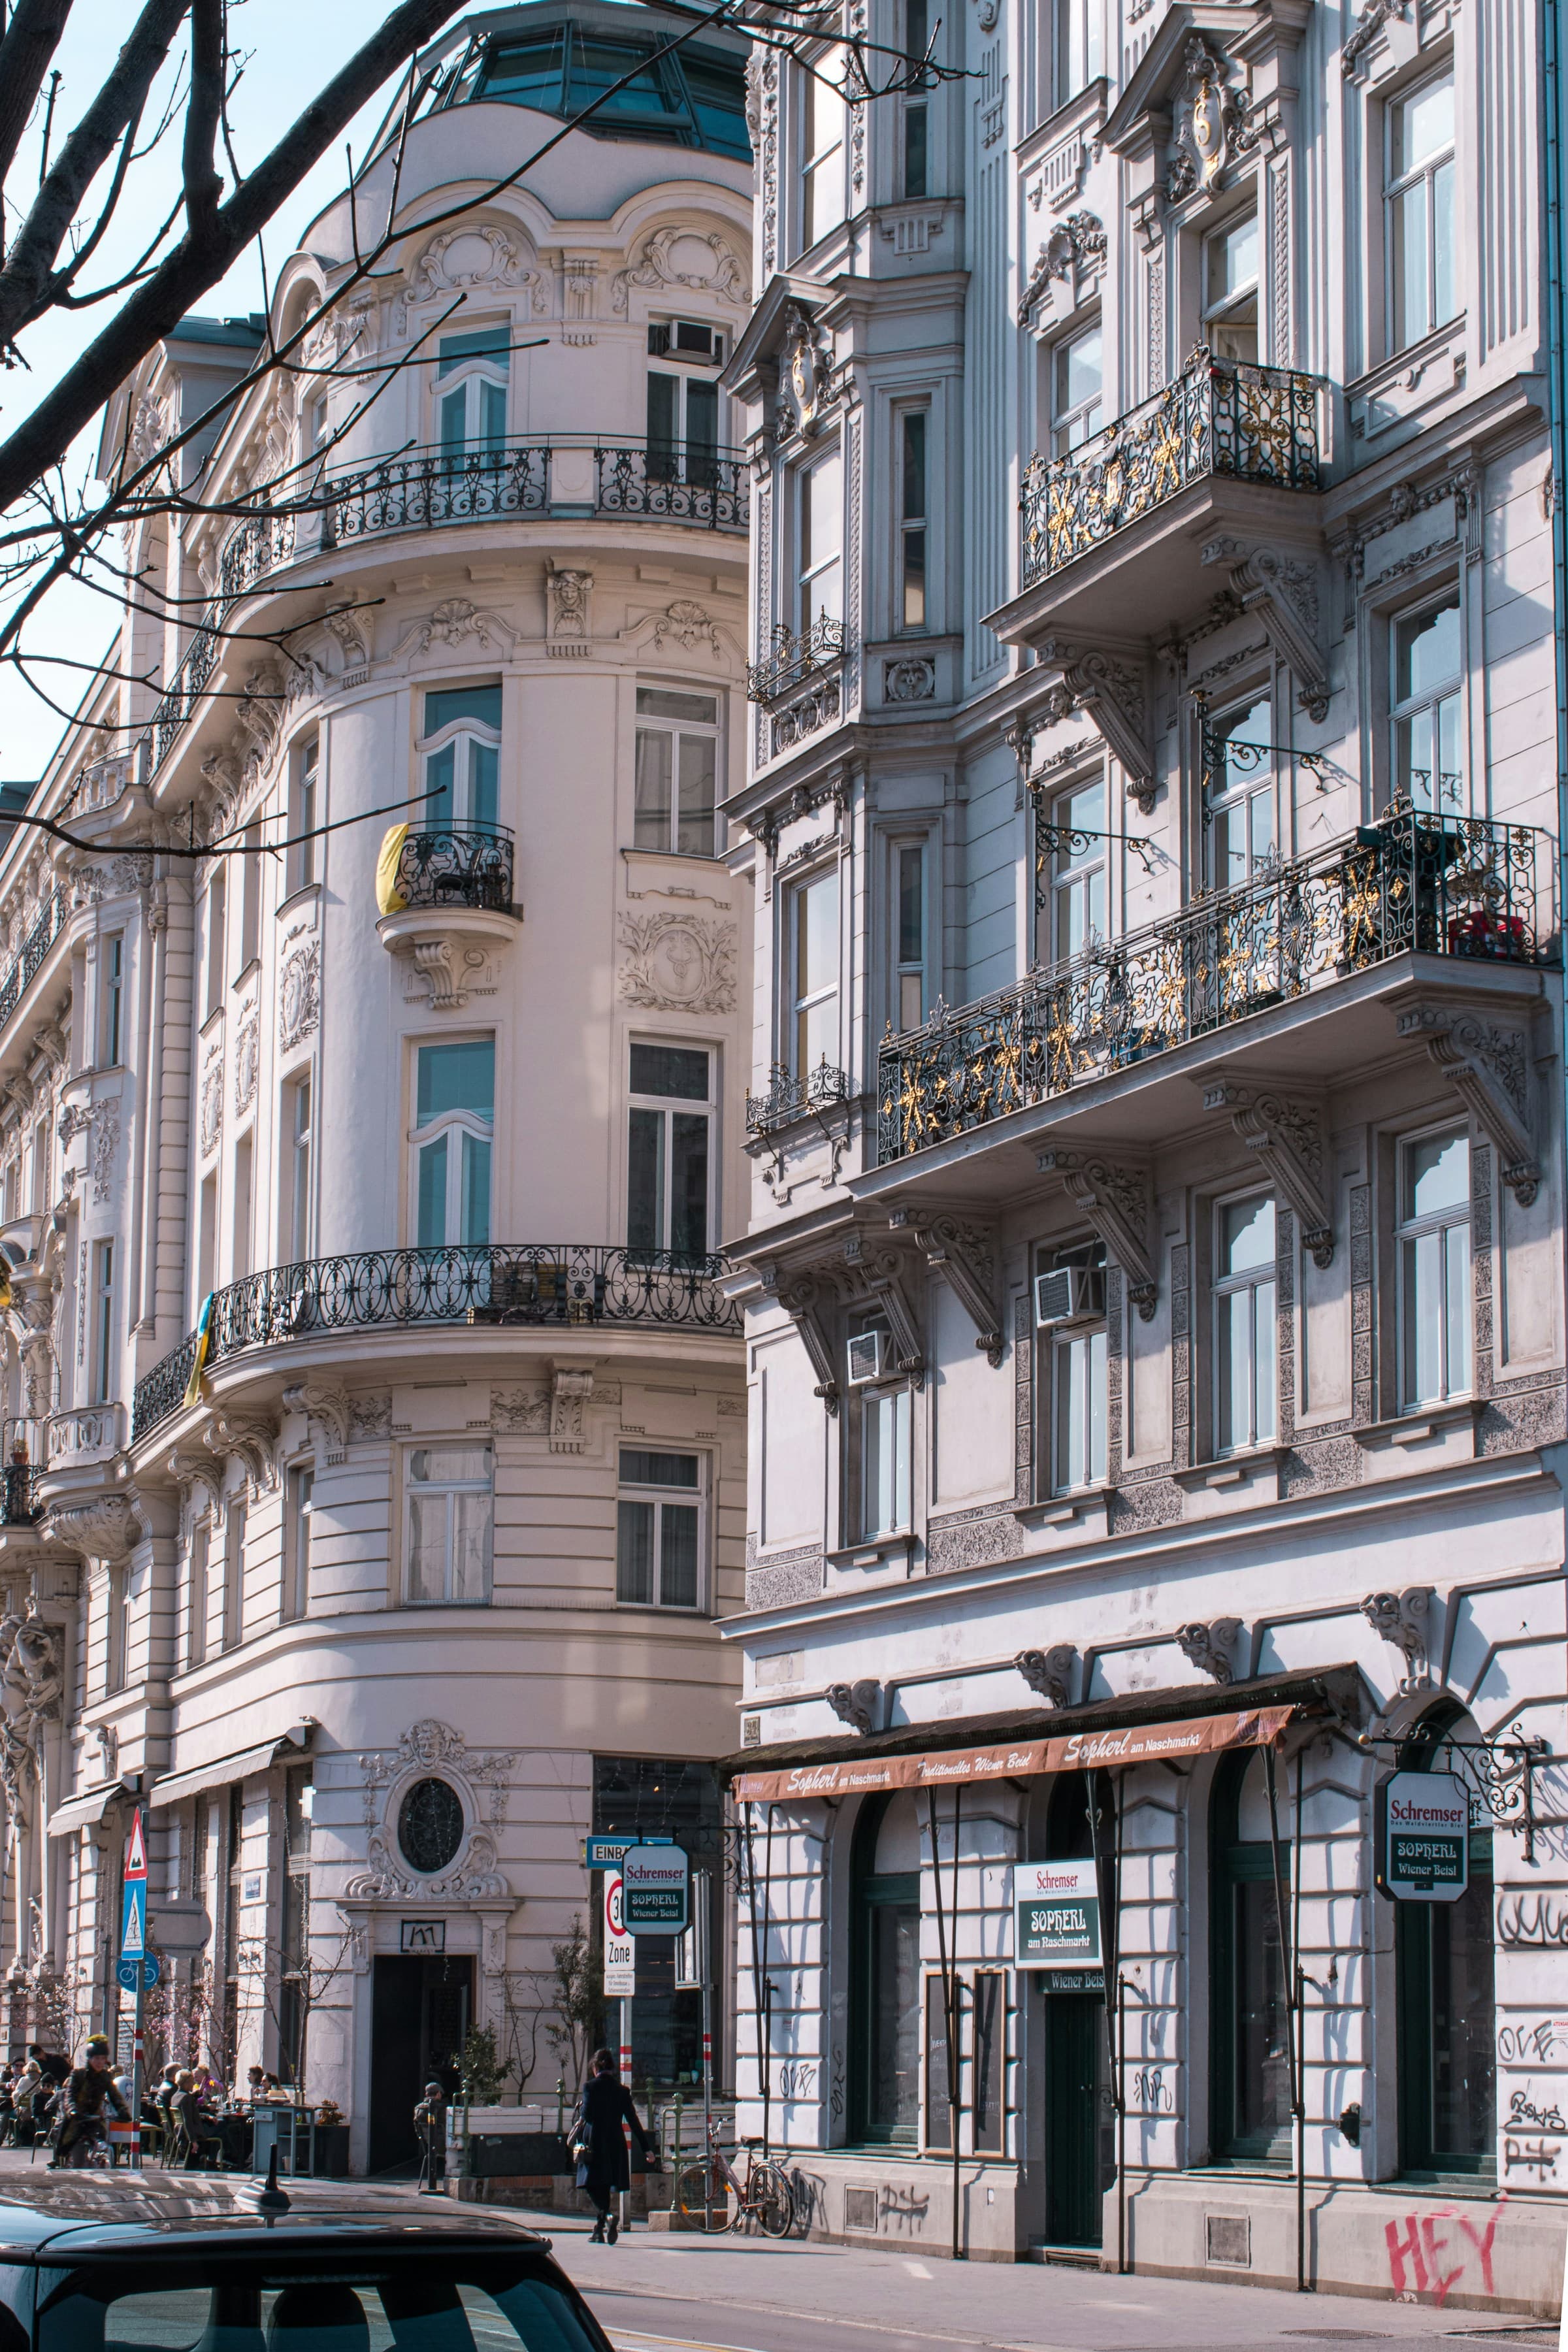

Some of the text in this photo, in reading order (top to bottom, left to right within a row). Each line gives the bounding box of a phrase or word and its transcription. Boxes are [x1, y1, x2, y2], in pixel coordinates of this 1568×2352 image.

[1064, 1732, 1200, 1765] Sopherl am Naschmarkt
[917, 1752, 1032, 1778] Traditionelles Wiener Beisl
[787, 1767, 890, 1795] Sopherl am Naschmarkt
[1391, 1800, 1463, 1821] Schremser
[596, 1846, 628, 1859] EINB
[1398, 1842, 1456, 1860] SOPHERL
[627, 1865, 684, 1879] Schremser
[1398, 1863, 1456, 1876] Wiener Beisl
[1037, 1870, 1078, 1889] Schremser
[632, 1895, 678, 1906] SOPHERL
[632, 1909, 678, 1918] Wiener Beisl
[1031, 1908, 1086, 1935] SOPHERL
[1028, 1935, 1090, 1948] am Naschmarkt
[609, 1942, 630, 1963] Zone
[1051, 1972, 1104, 1989] Wiener Beis
[1385, 2197, 1508, 2309] HEY
